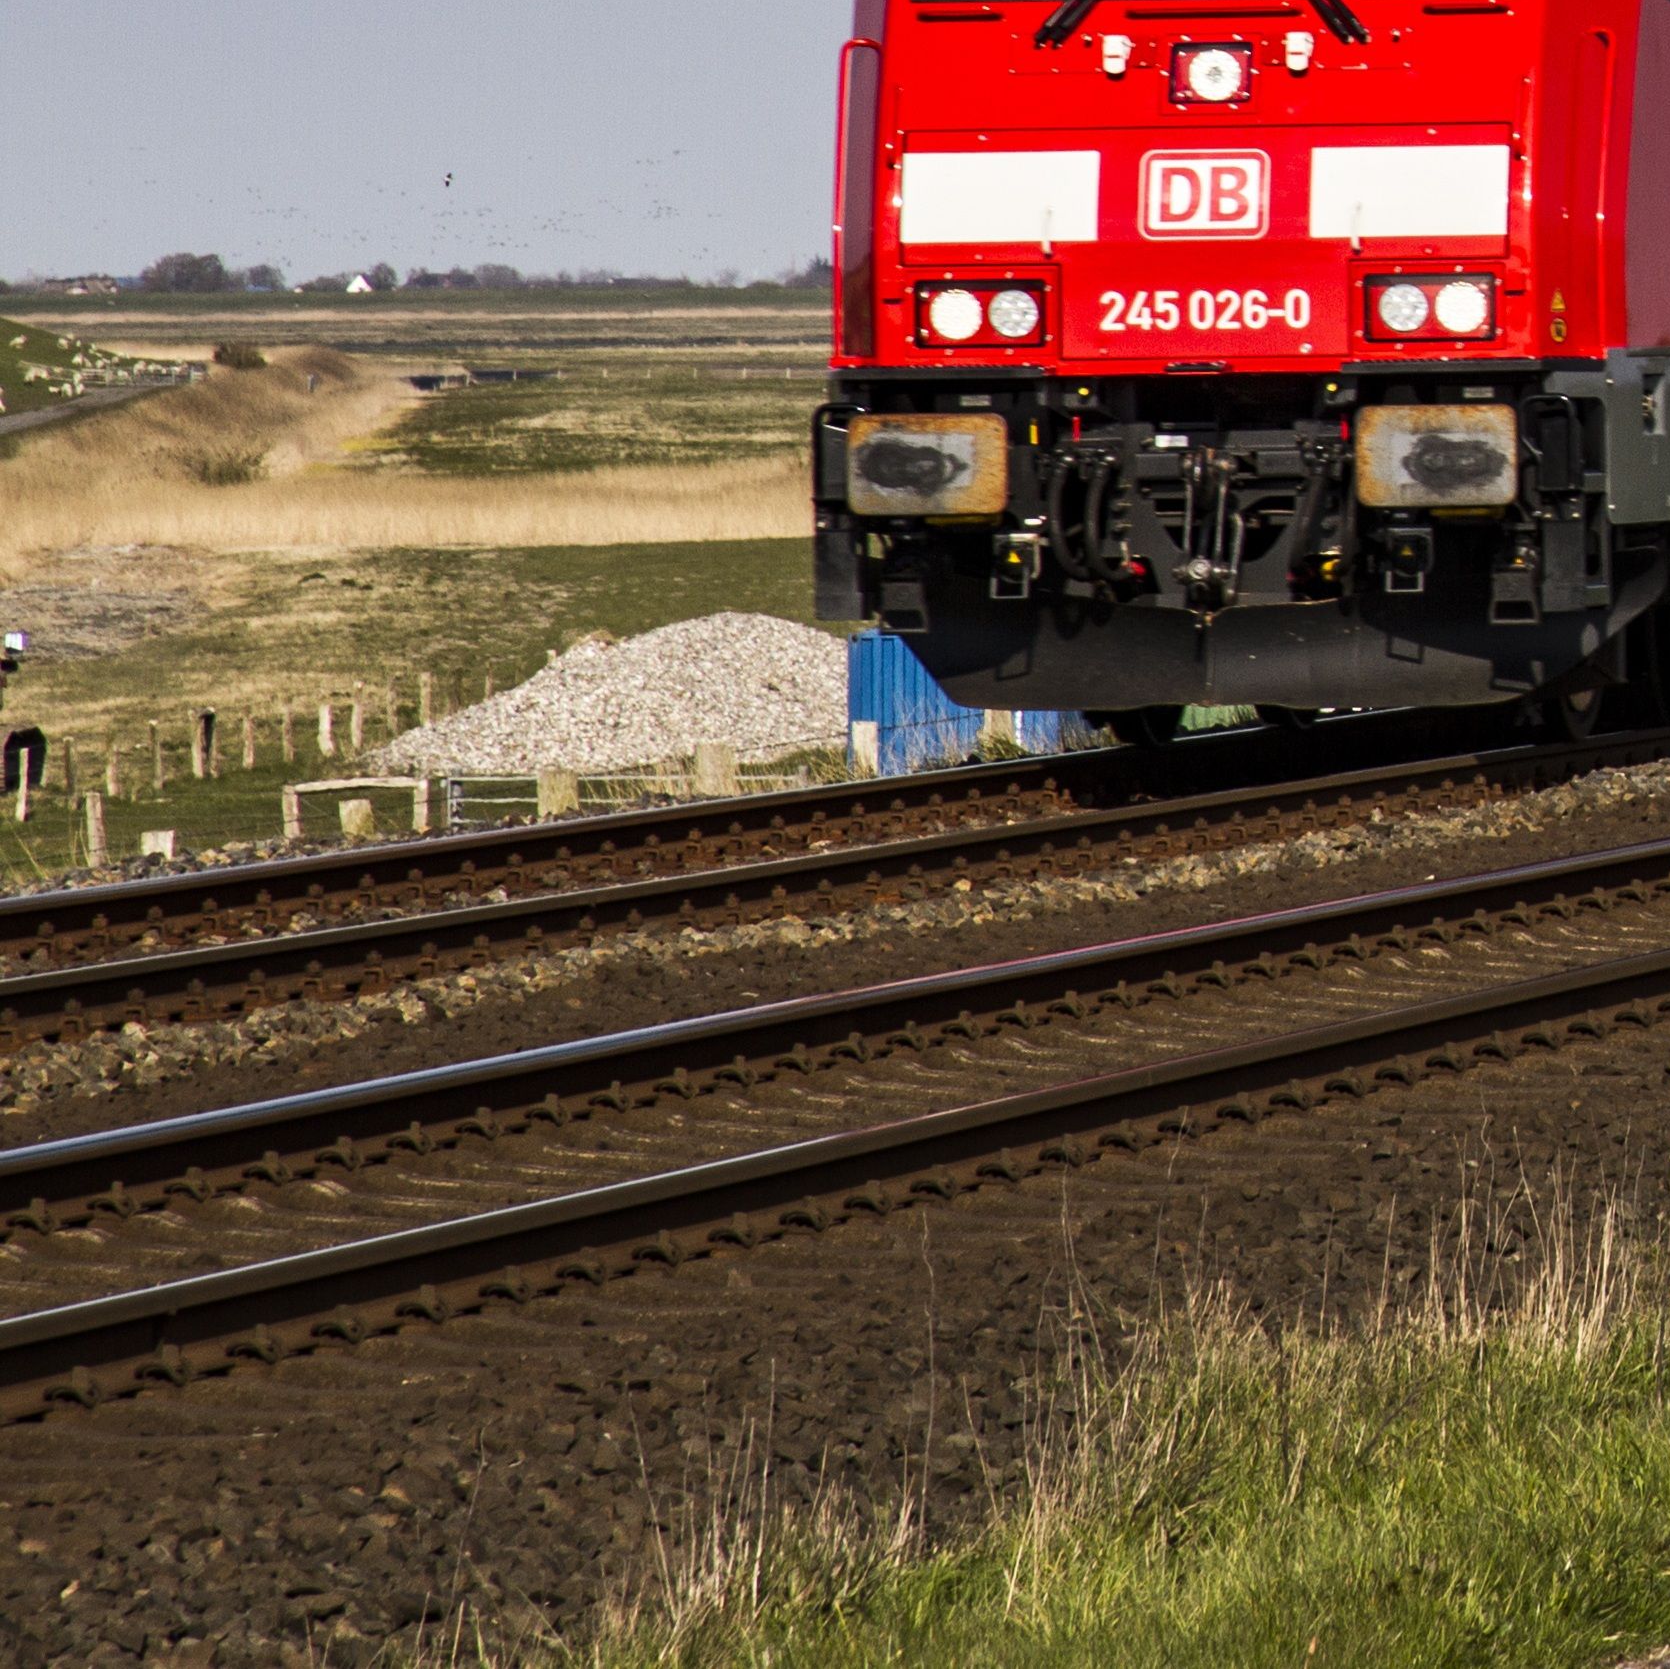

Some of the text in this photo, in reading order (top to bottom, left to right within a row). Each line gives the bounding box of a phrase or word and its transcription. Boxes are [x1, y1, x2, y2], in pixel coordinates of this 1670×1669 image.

[1160, 166, 1249, 222] DB
[1100, 288, 1311, 330] 245 026-0
